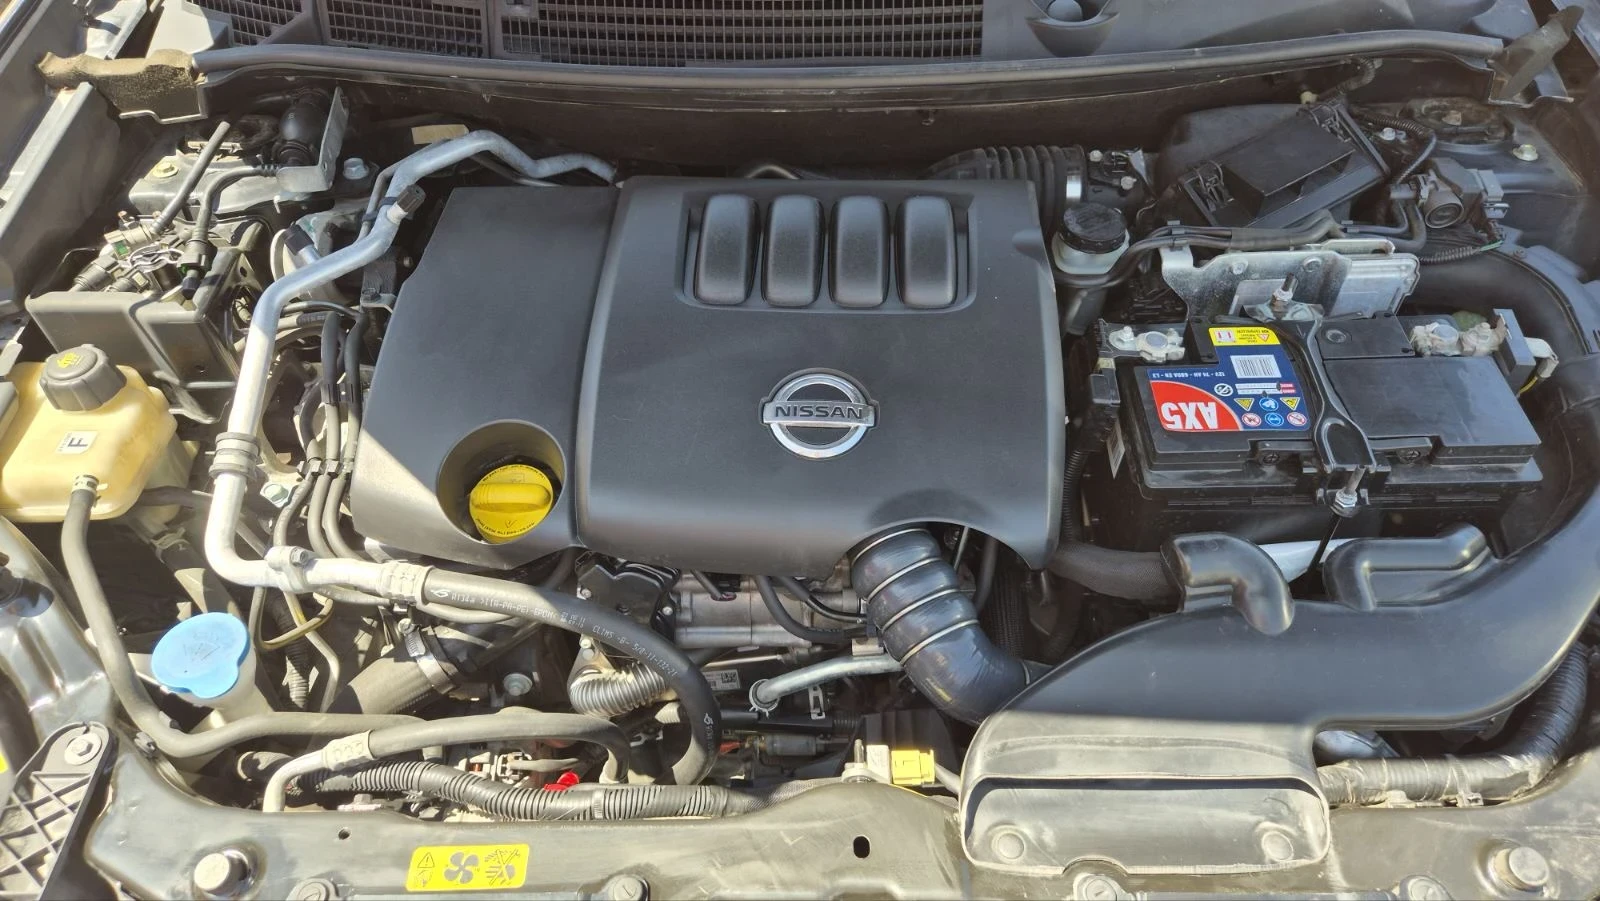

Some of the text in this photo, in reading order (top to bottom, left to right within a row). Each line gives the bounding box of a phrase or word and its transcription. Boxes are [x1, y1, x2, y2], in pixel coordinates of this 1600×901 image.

[775, 405, 863, 420] NISSAN
[1161, 402, 1219, 430] AX5
[68, 437, 88, 447] F
